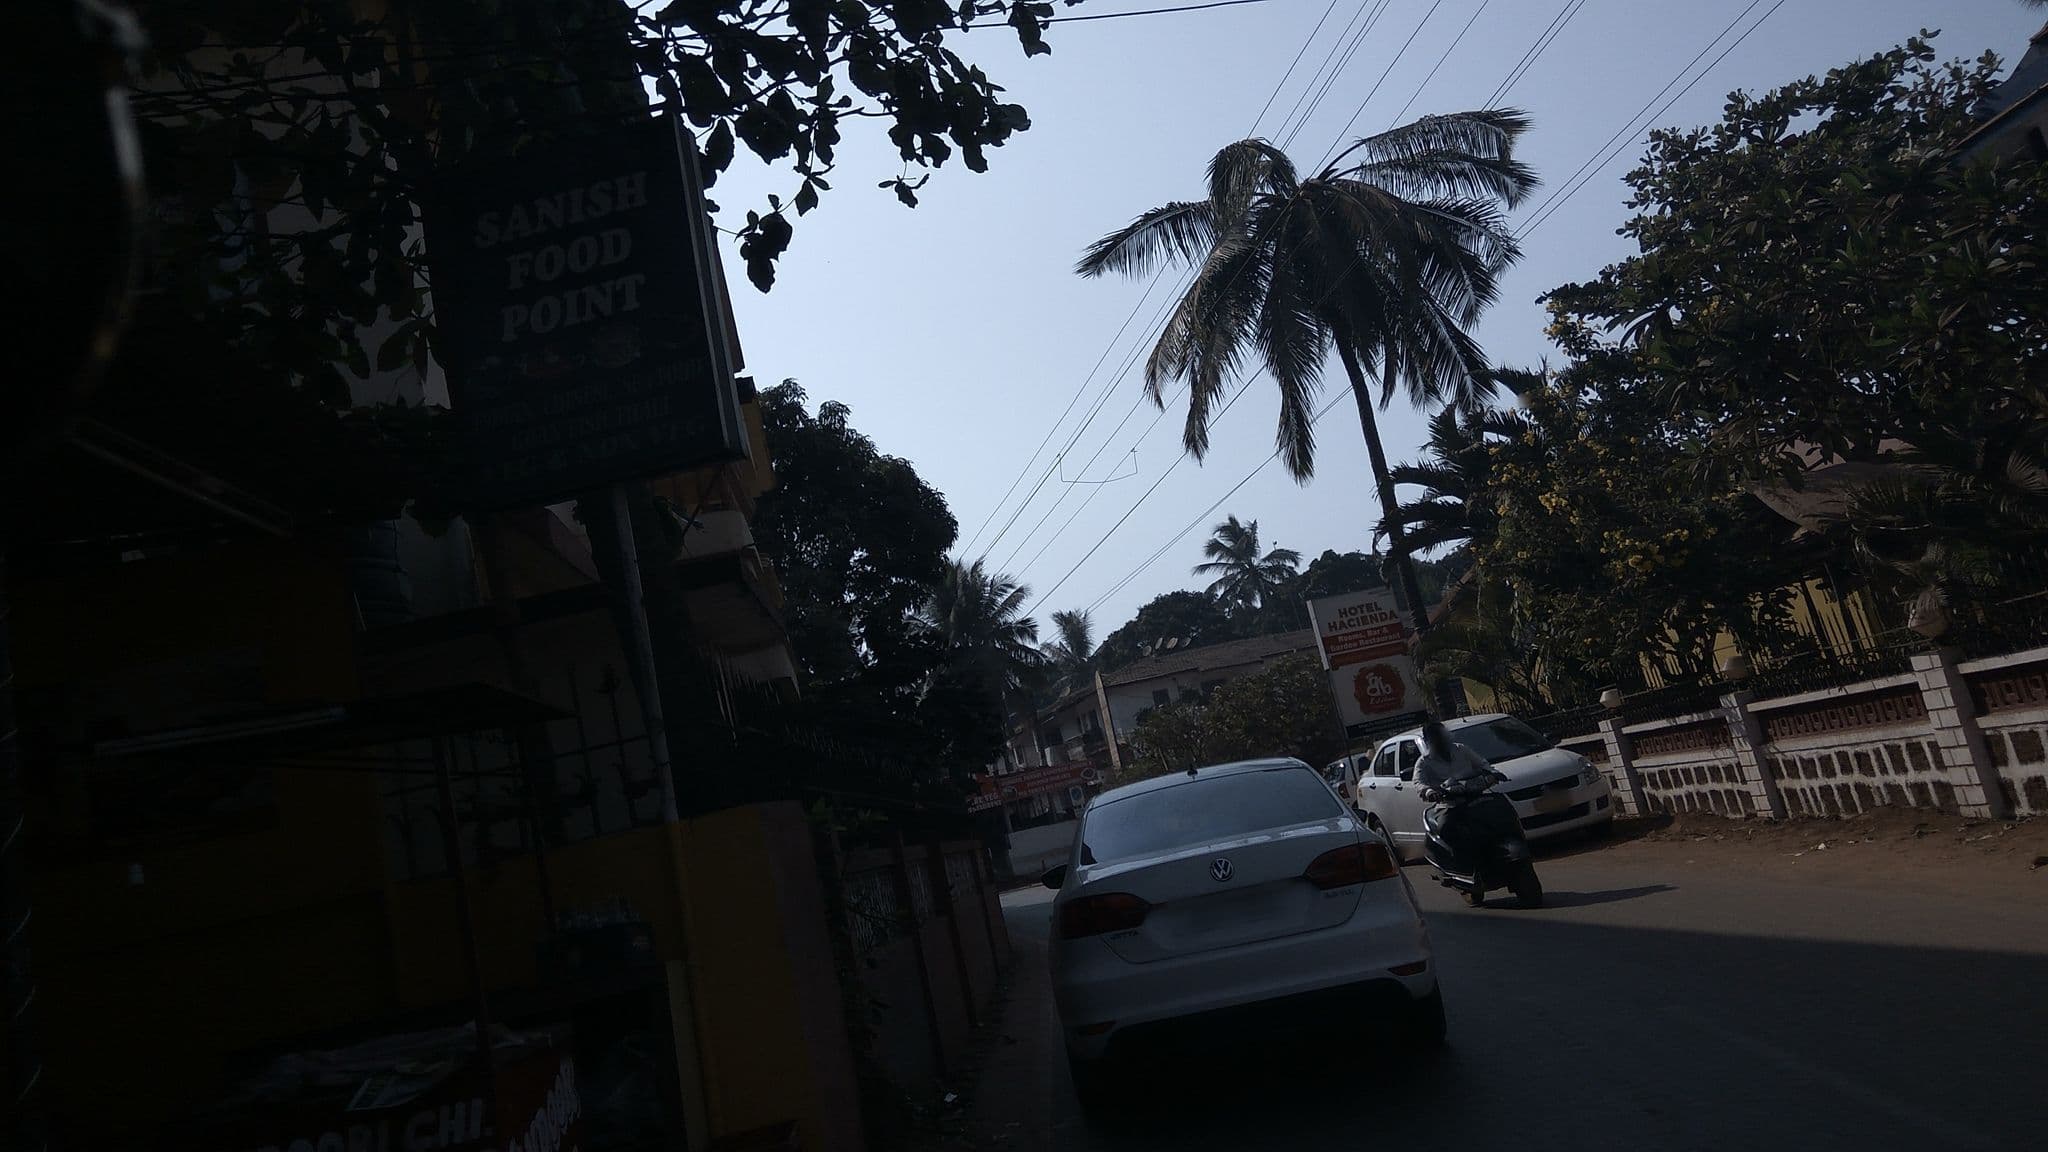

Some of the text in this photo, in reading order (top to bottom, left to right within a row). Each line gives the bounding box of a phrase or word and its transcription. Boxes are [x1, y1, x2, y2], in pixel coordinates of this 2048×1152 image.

[473, 171, 648, 248] SANISH
[505, 227, 632, 291] FOOD
[500, 273, 646, 342] POINT
[1328, 610, 1398, 632] HACIENDA
[1338, 602, 1382, 618] HOTEL
